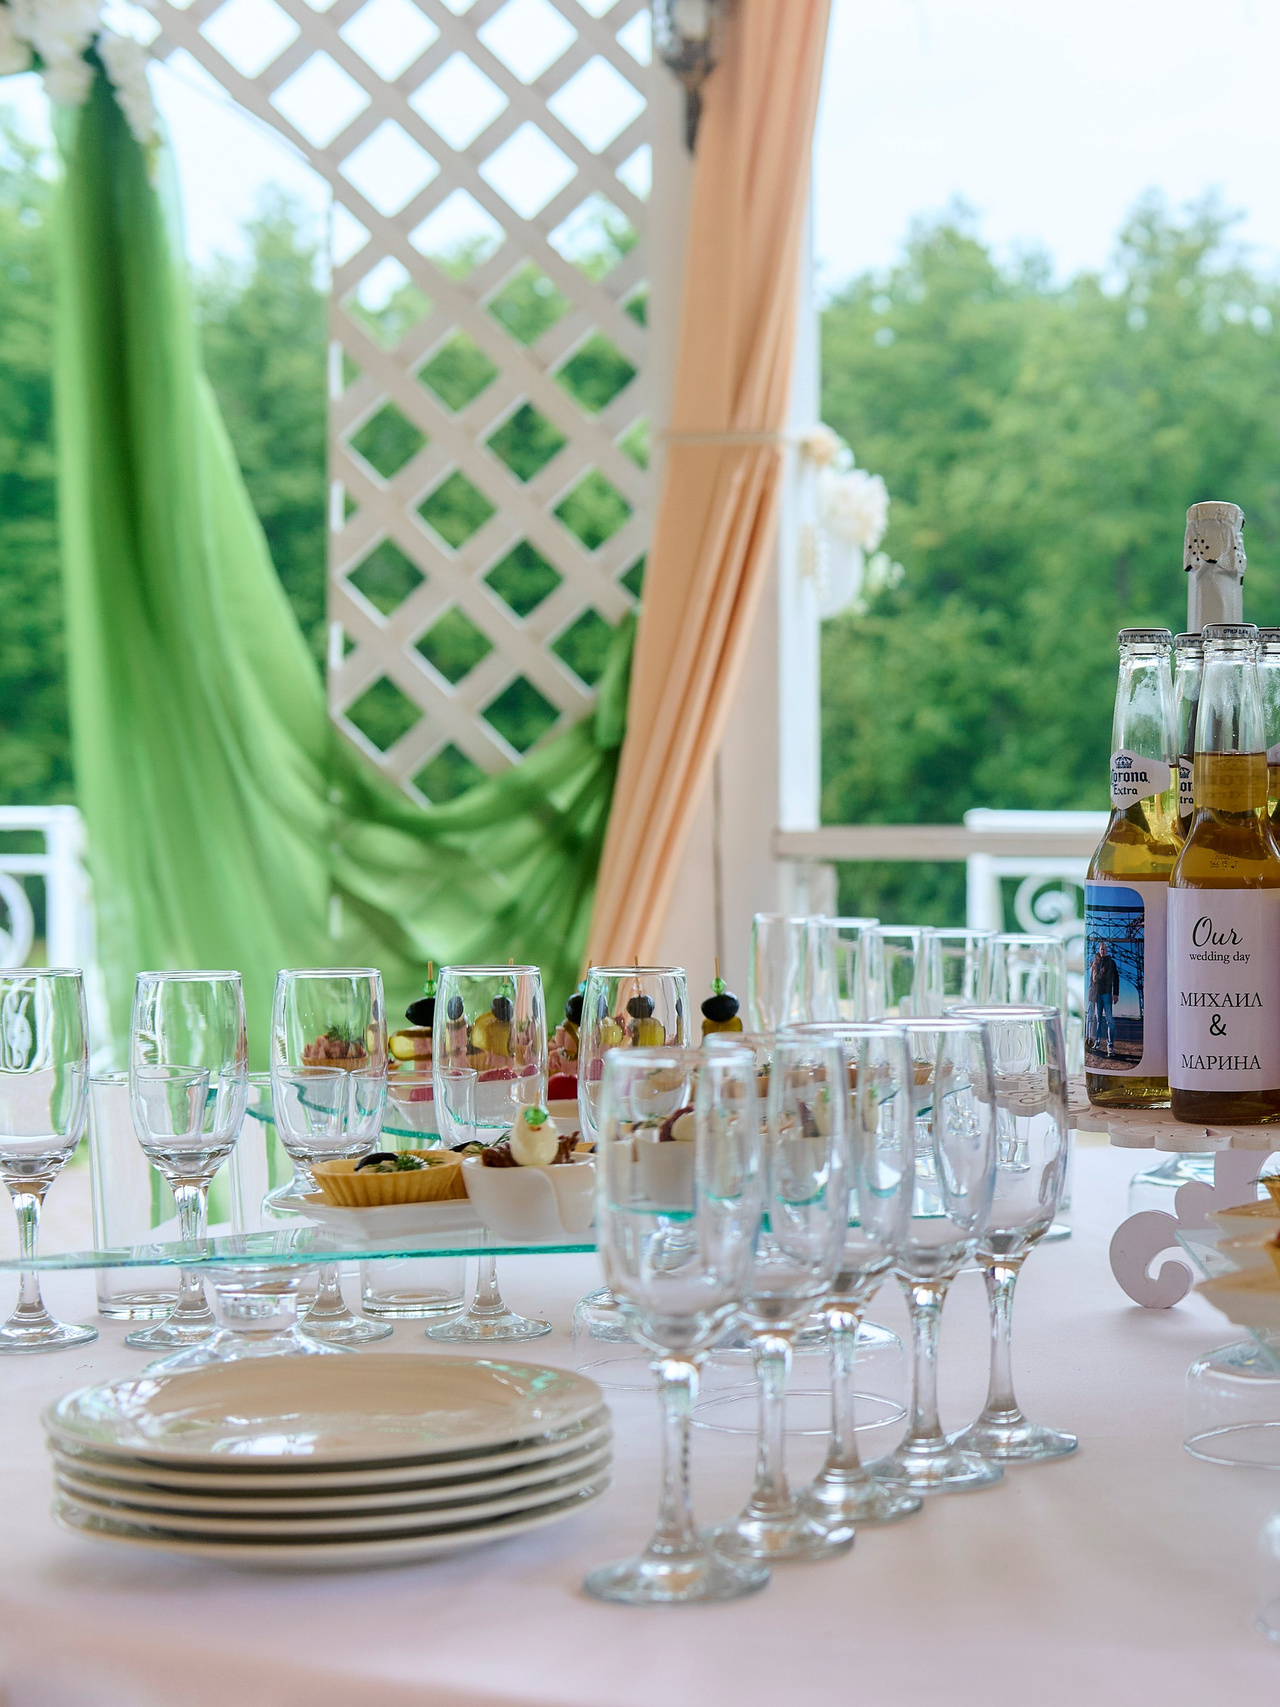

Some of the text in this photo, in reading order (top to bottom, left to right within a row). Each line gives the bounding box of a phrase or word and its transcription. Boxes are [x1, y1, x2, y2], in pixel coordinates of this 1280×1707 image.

[1114, 784, 1138, 795] Extra
[1192, 916, 1243, 947] Our
[1189, 951, 1251, 964] wedding day
[1180, 992, 1263, 1008] МИХАИЛ
[1209, 1014, 1227, 1036] &
[1181, 1054, 1262, 1071] МАРИНА
